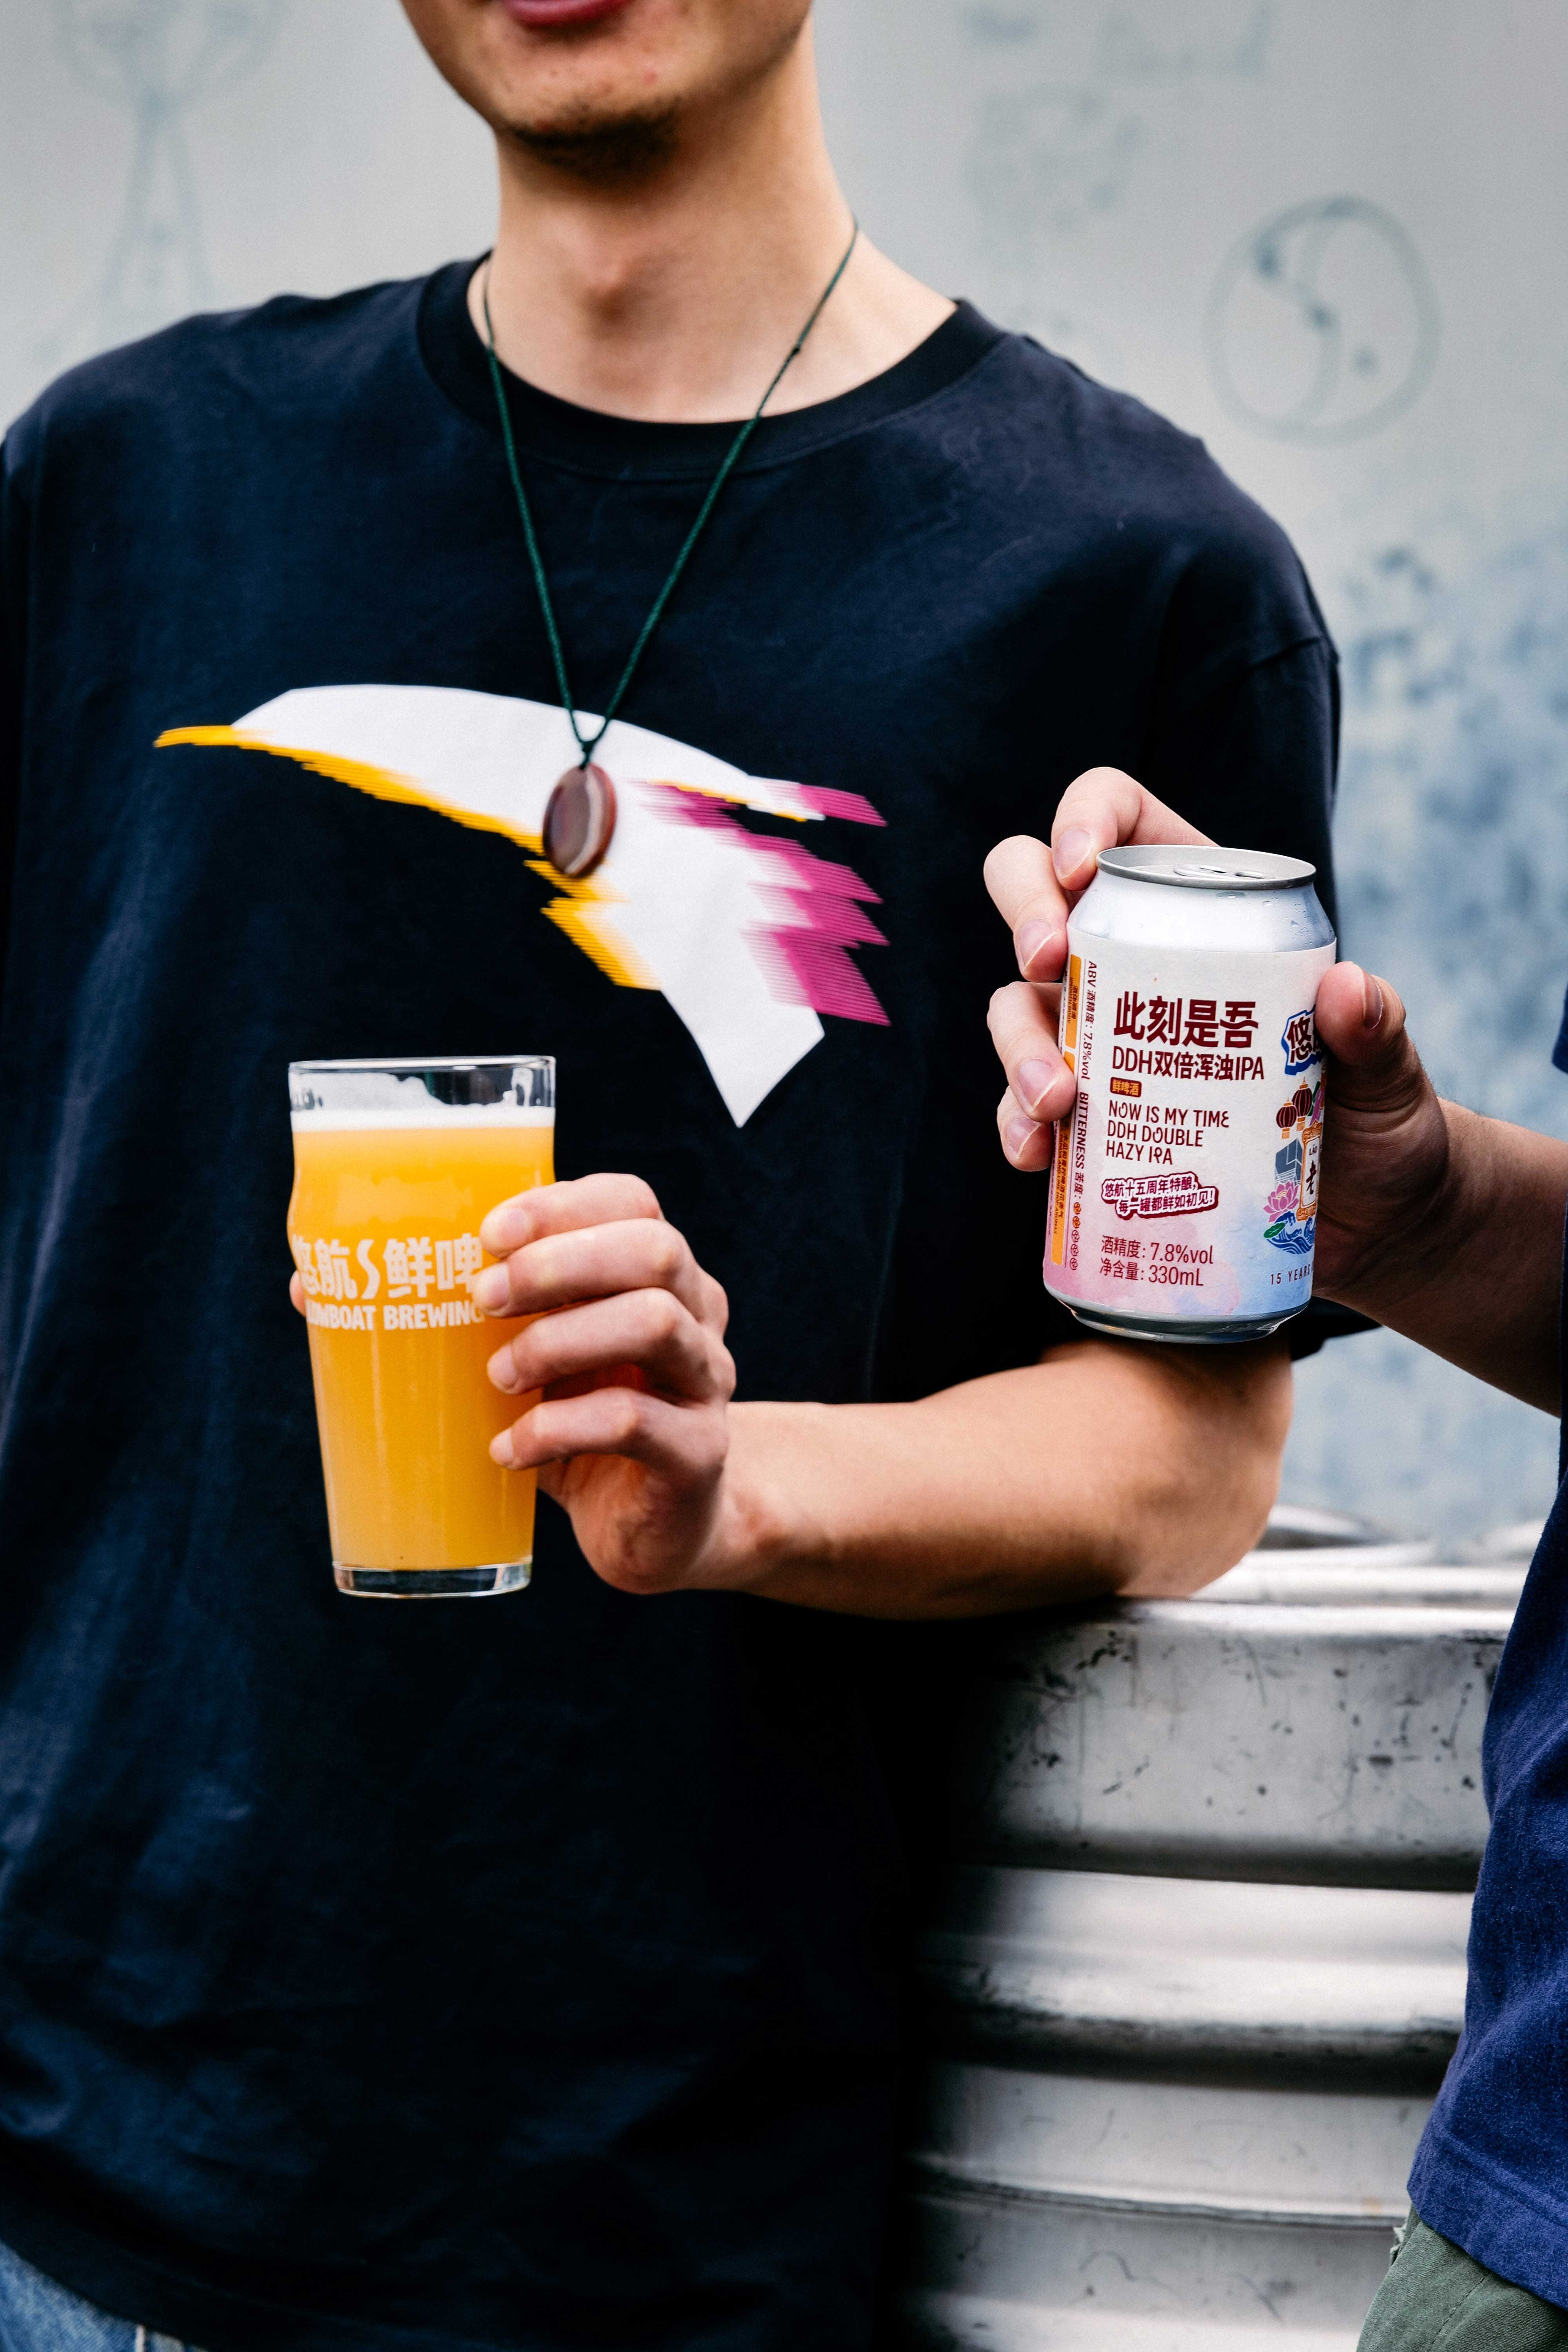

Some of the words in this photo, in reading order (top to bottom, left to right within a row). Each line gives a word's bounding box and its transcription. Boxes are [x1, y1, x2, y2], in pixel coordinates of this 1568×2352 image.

[1087, 960, 1097, 987] ABV
[1114, 991, 1258, 1048] 此刻是吾
[1112, 1079, 1140, 1096] 鲜啤酒
[1109, 1100, 1142, 1121] NOW
[1146, 1105, 1160, 1123] IS
[1165, 1107, 1188, 1125] MY
[1193, 1110, 1229, 1128] TIME
[1075, 1092, 1089, 1169] BITTERNESS
[1108, 1120, 1136, 1140] DDH
[1142, 1125, 1203, 1147] DOUBLE
[1106, 1140, 1144, 1161] HAZY
[1149, 1146, 1173, 1165] IPA
[1306, 1160, 1317, 1194] 老
[1271, 1272, 1281, 1285] 15
[1288, 1264, 1310, 1282] YEARS
